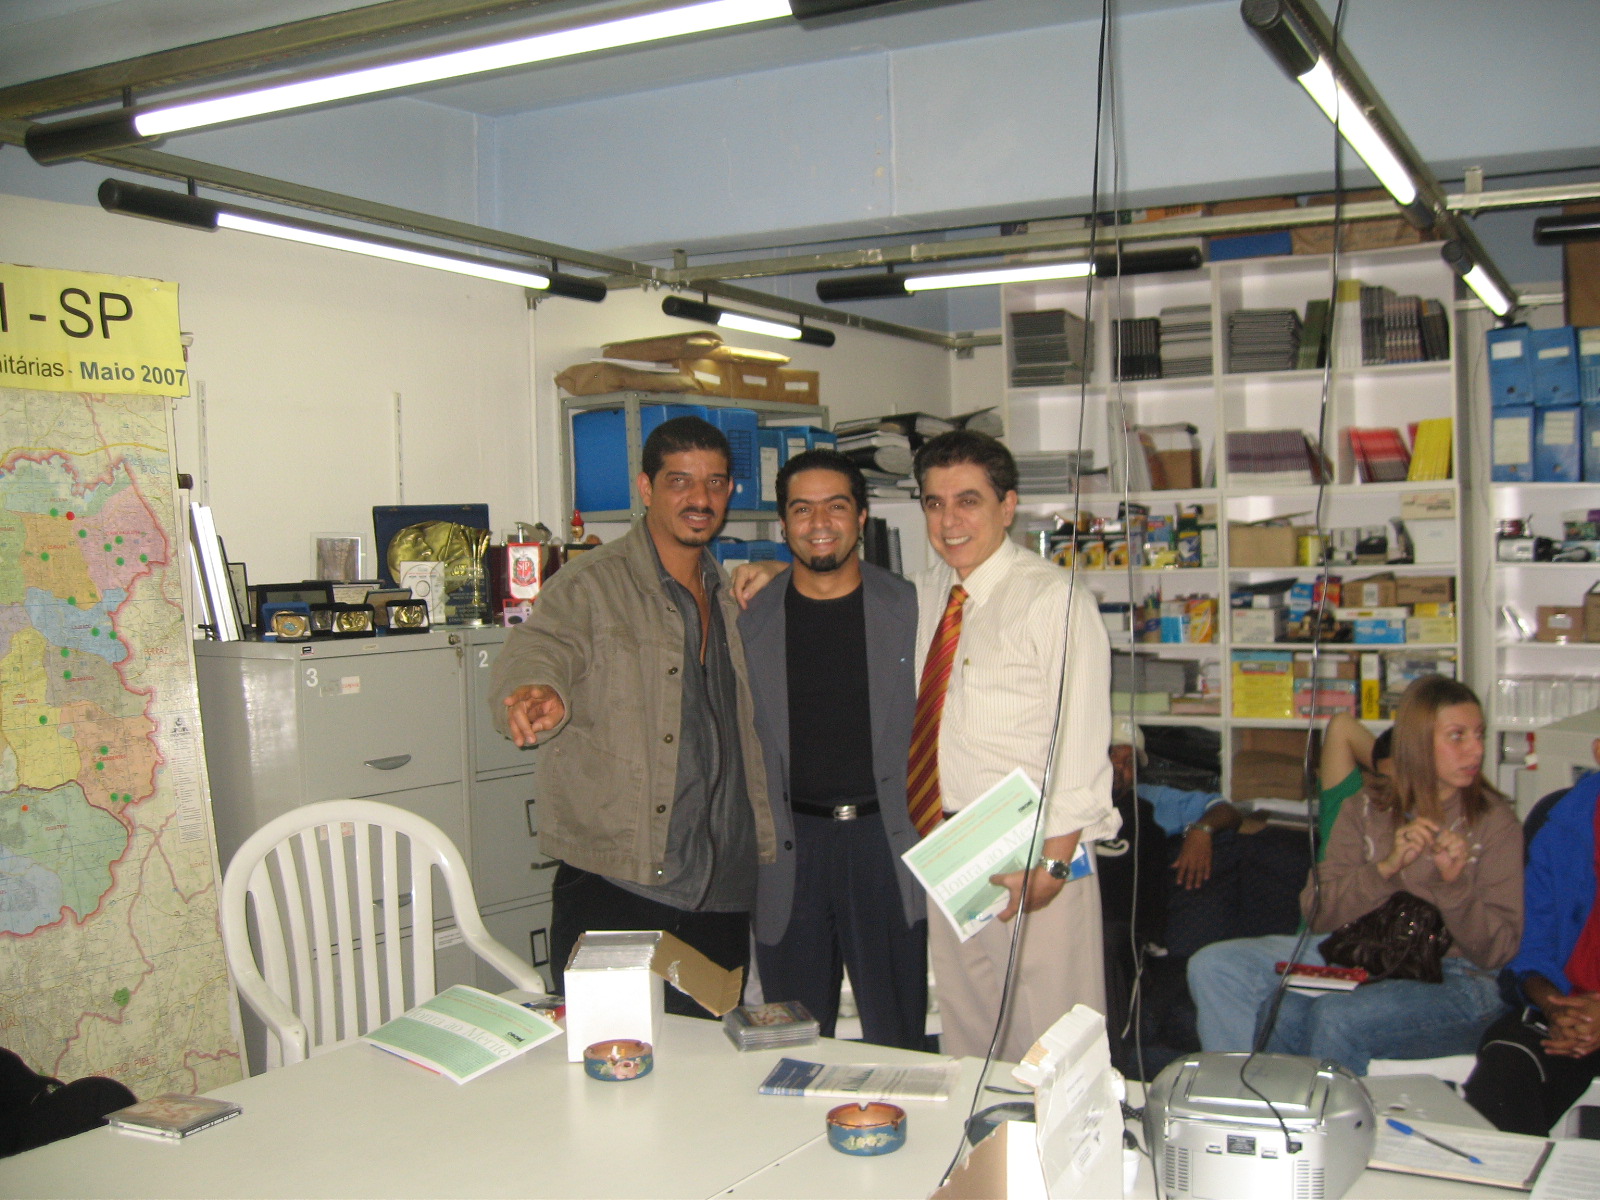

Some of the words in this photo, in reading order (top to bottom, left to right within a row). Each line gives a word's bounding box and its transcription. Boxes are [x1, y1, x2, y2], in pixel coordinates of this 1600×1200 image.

[80, 361, 135, 381] Maio
[140, 364, 186, 386] 2007
[479, 650, 488, 668] 2
[306, 668, 318, 688] 3
